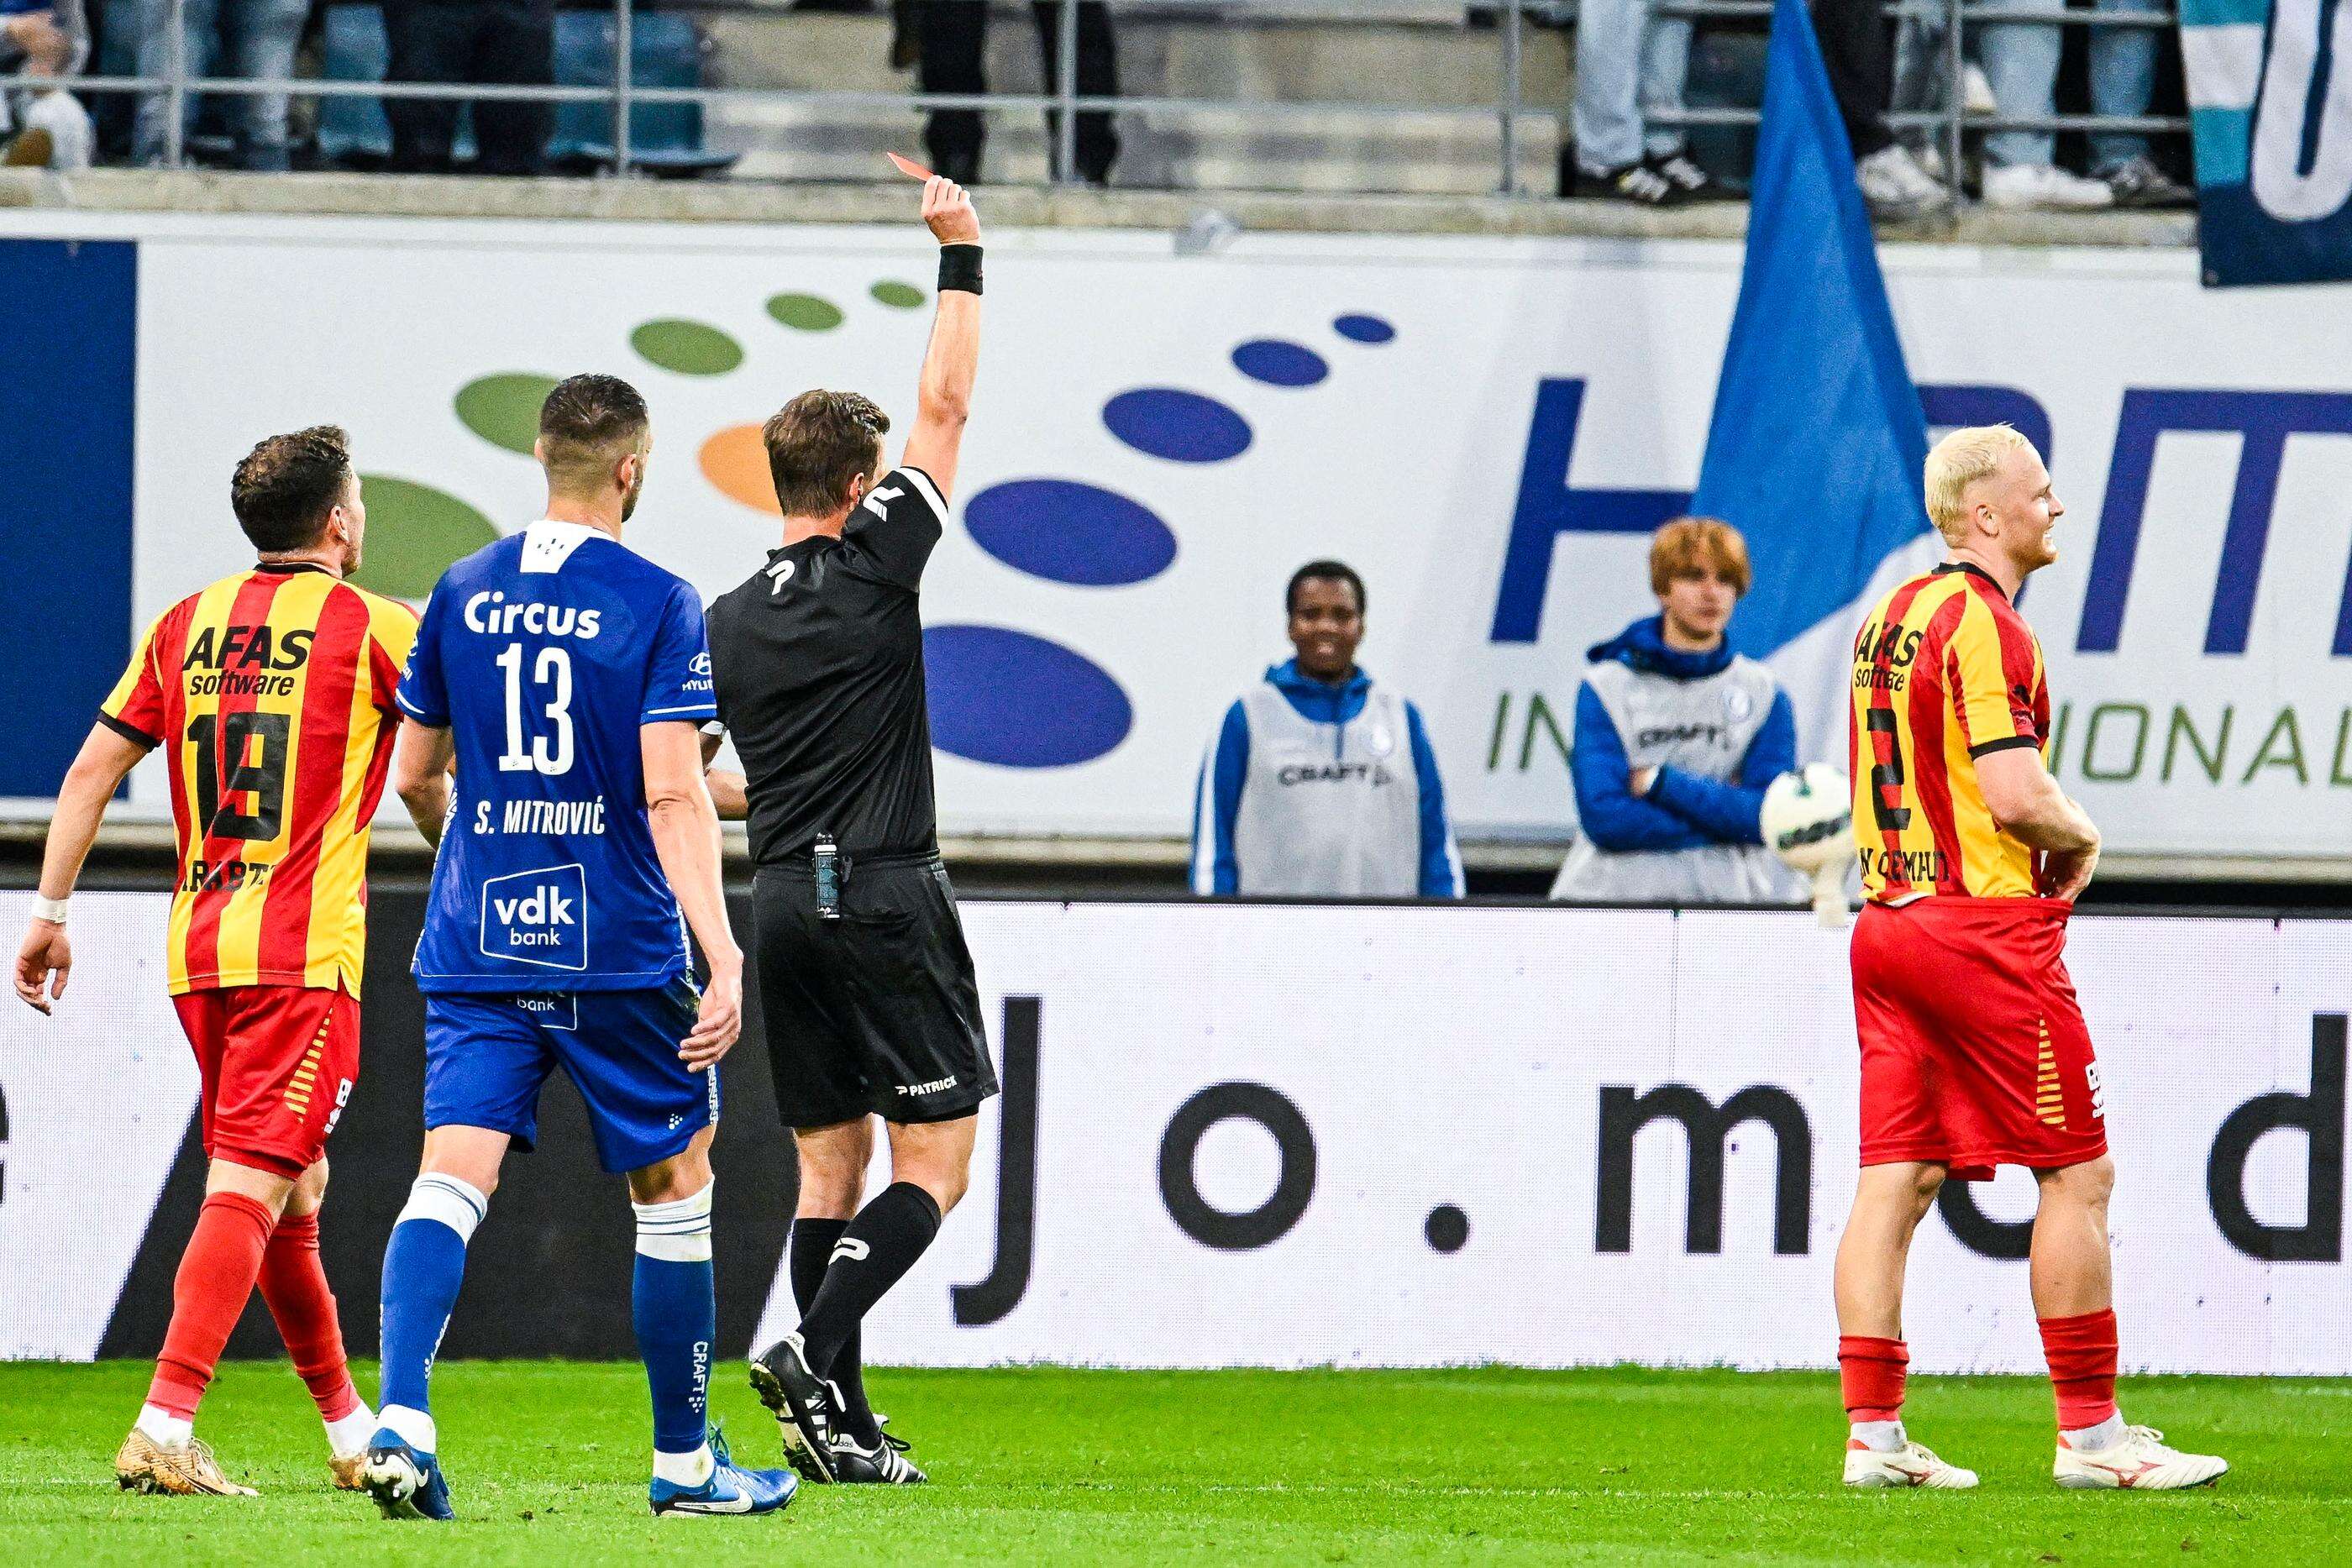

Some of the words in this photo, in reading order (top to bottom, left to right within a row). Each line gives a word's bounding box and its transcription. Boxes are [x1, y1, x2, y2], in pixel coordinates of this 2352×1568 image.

[464, 591, 601, 639] Circus
[181, 625, 317, 671] AFAS
[189, 669, 295, 696] software
[496, 642, 575, 776] 13
[186, 711, 291, 842] 19
[1866, 708, 1912, 831] 2
[474, 800, 495, 835] S.
[502, 794, 605, 836] MITROVIĆ
[493, 885, 576, 926] vdk
[510, 927, 562, 946] bank
[517, 994, 555, 1012] bank
[909, 1075, 958, 1097] PATRICK
[693, 1340, 709, 1394] CRAFT
